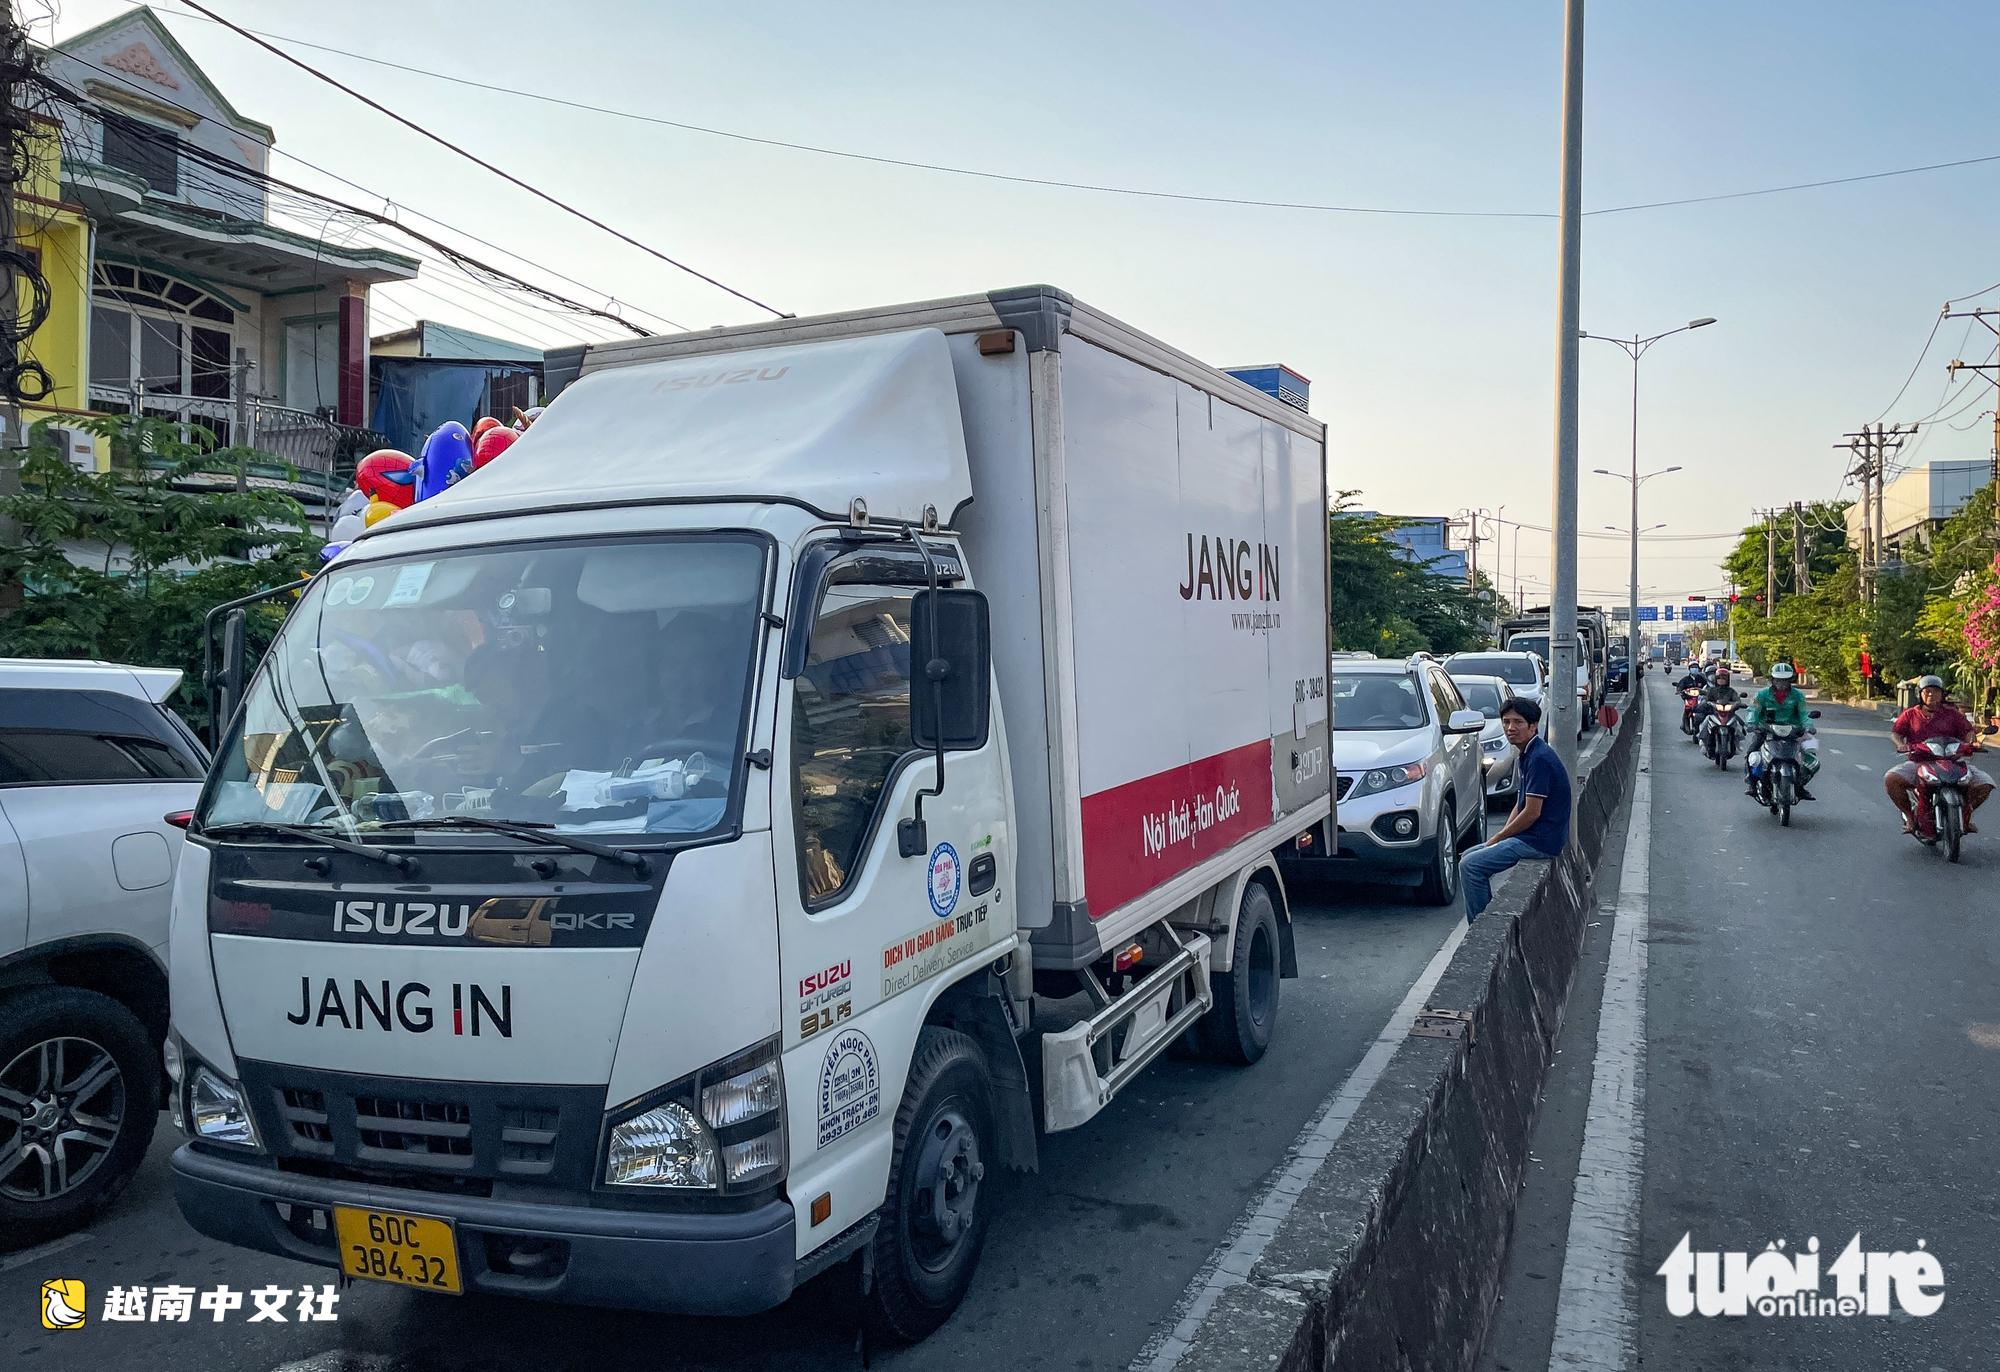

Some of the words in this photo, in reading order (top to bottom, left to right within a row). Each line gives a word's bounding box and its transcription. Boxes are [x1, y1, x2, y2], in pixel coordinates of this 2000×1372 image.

[655, 366, 791, 392] ISUZU
[924, 563, 957, 575] IUZU
[1180, 532, 1252, 601] JANG
[1143, 813, 1166, 859] Nội
[1168, 799, 1190, 845] thất
[1216, 779, 1240, 822] Quốc
[333, 900, 470, 937] ISUZU
[550, 912, 635, 932] QKR
[884, 944, 903, 970] DỊCH
[905, 939, 915, 960] VỤ
[917, 931, 934, 953] GIAO
[936, 919, 955, 943] HÀNG
[975, 900, 988, 924] TIẾP
[800, 959, 851, 997] ISUZU
[884, 974, 910, 997] Direct
[912, 957, 945, 983] Delivery
[947, 941, 974, 963] Service
[287, 976, 434, 1033] JANG
[452, 982, 513, 1038] IN
[800, 1006, 834, 1039] 91
[837, 1001, 852, 1021] PS
[822, 1046, 839, 1115] NGUYỄN
[840, 1037, 863, 1052] NGỌC
[863, 1049, 876, 1088] PHÚC
[851, 1066, 861, 1079] 3N
[820, 1114, 841, 1133] NHƠN
[842, 1100, 864, 1119] TRẠCH
[869, 1093, 878, 1106] ĐN
[820, 1125, 843, 1145] 0933
[844, 1115, 860, 1131] 810
[862, 1105, 878, 1120] 469
[368, 1214, 420, 1249] 60C
[352, 1245, 448, 1287] 384.32
